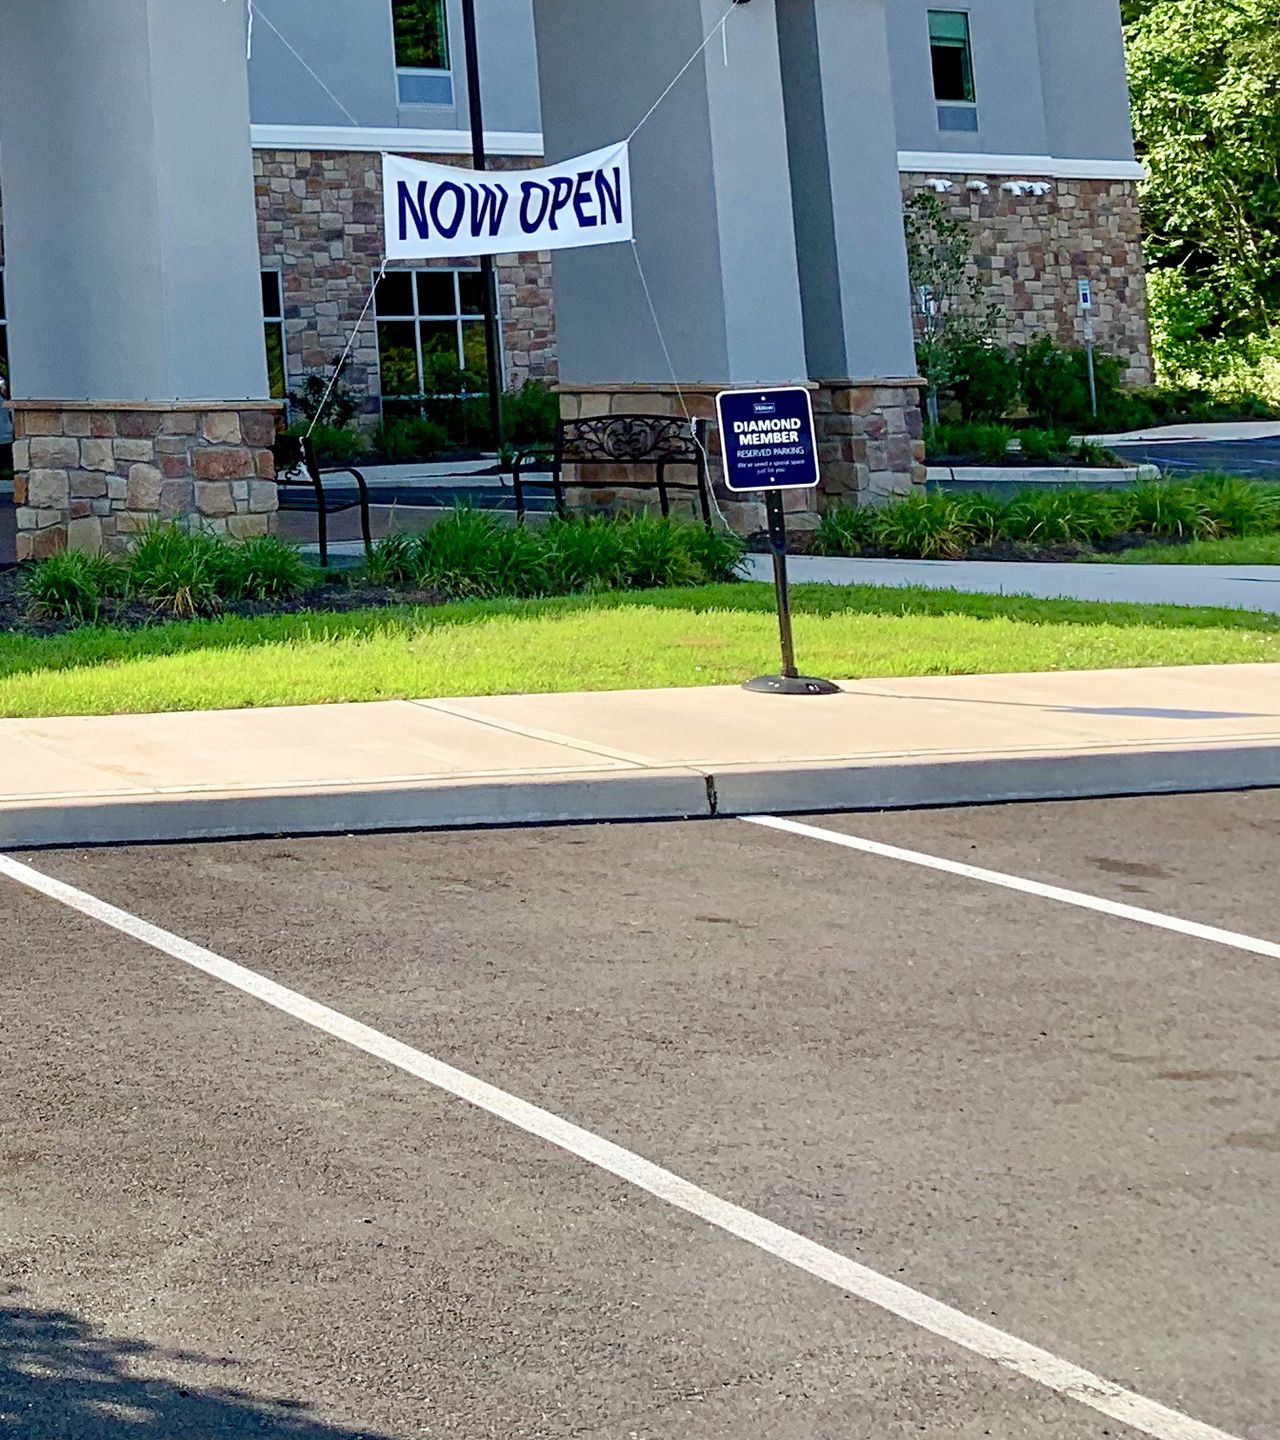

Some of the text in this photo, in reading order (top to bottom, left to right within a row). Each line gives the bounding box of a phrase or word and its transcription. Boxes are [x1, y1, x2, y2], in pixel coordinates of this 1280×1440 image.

[397, 167, 623, 240] NOW OPEN
[733, 418, 801, 433] DIAMOND
[739, 431, 799, 445] MEMBER
[737, 446, 804, 458] RESERVED PARKING
